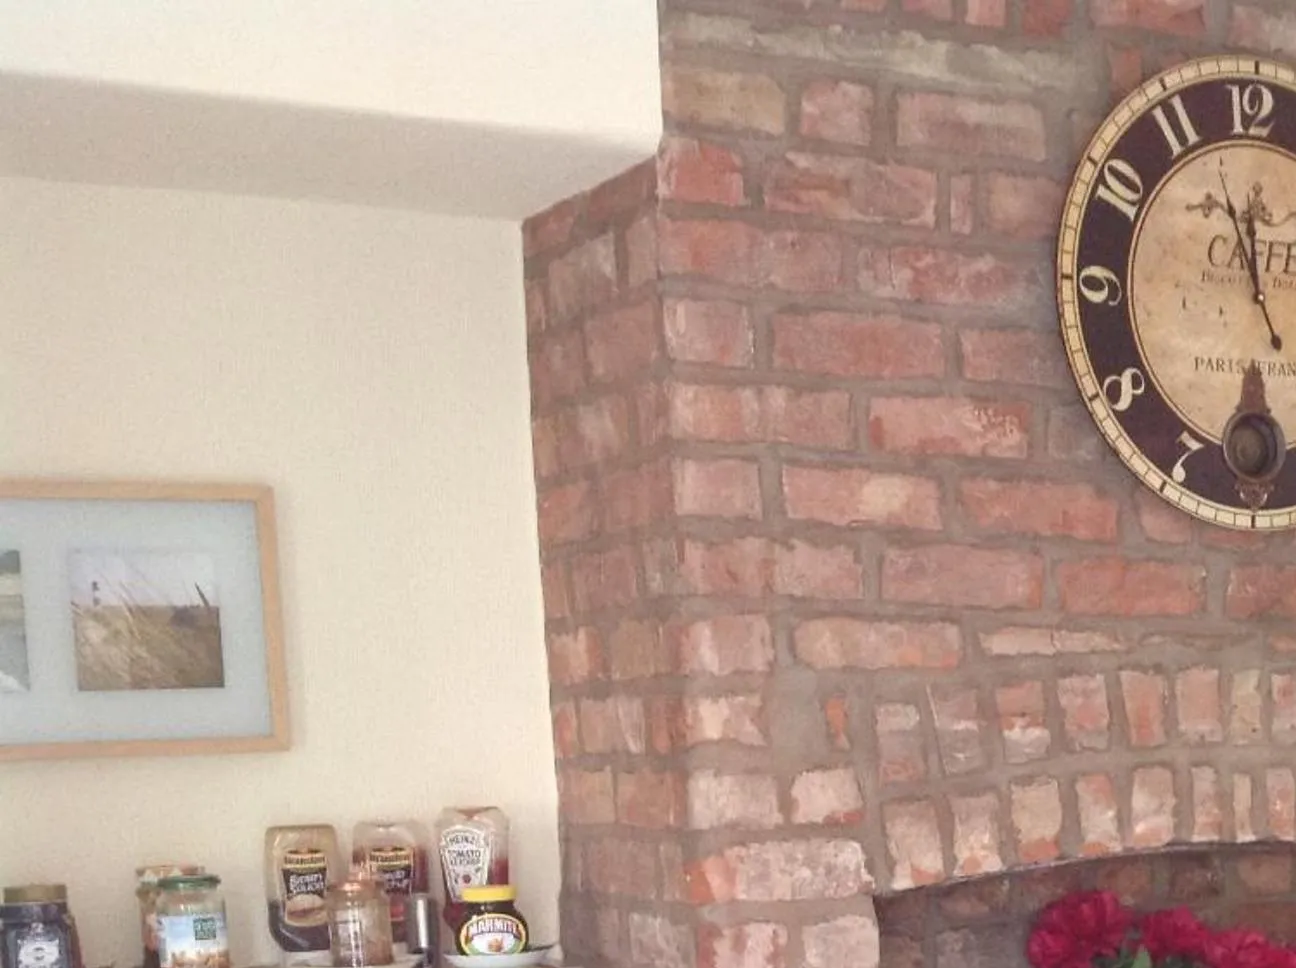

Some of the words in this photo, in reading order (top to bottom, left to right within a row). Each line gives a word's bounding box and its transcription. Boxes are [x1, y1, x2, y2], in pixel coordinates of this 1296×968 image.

[1150, 94, 1204, 160] 11
[1225, 83, 1275, 138] 12
[1095, 157, 1145, 223] 10
[1079, 264, 1123, 307] 9
[1101, 366, 1146, 412] 8
[1171, 429, 1206, 485] 7
